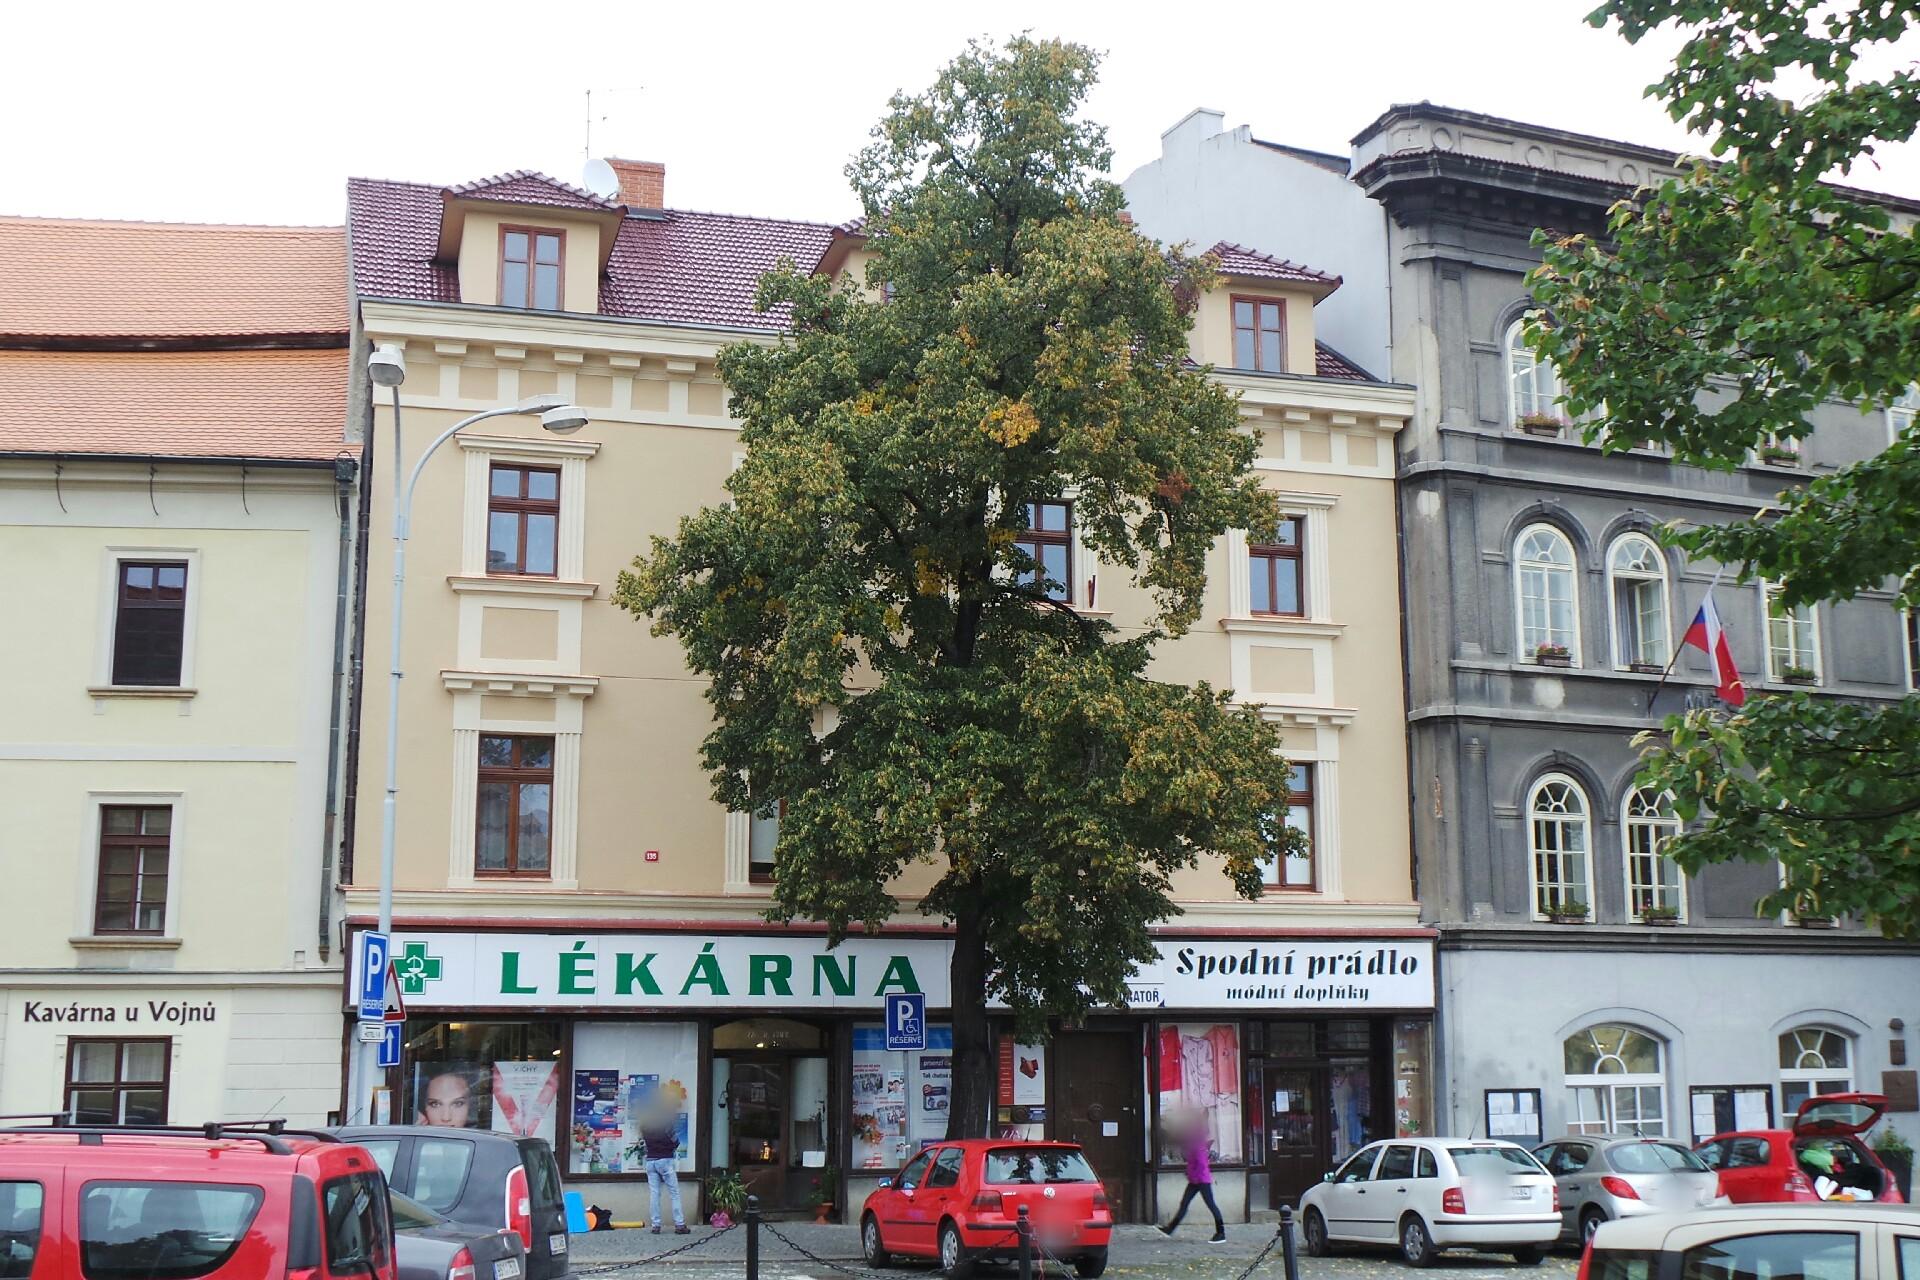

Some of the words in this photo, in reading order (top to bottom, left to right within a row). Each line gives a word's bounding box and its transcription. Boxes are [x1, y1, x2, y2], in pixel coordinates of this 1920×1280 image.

[366, 944, 382, 991] P
[500, 941, 921, 996] LÉKÁRNA
[1176, 947, 1296, 979] Spodní
[1307, 949, 1418, 979] prádlo
[1226, 985, 1286, 1000] módní
[1294, 985, 1369, 1002] doplňky
[24, 1001, 115, 1023] Kavárna
[126, 1007, 138, 1022] u
[148, 1001, 216, 1026] Vojnů
[897, 1000, 914, 1031] P
